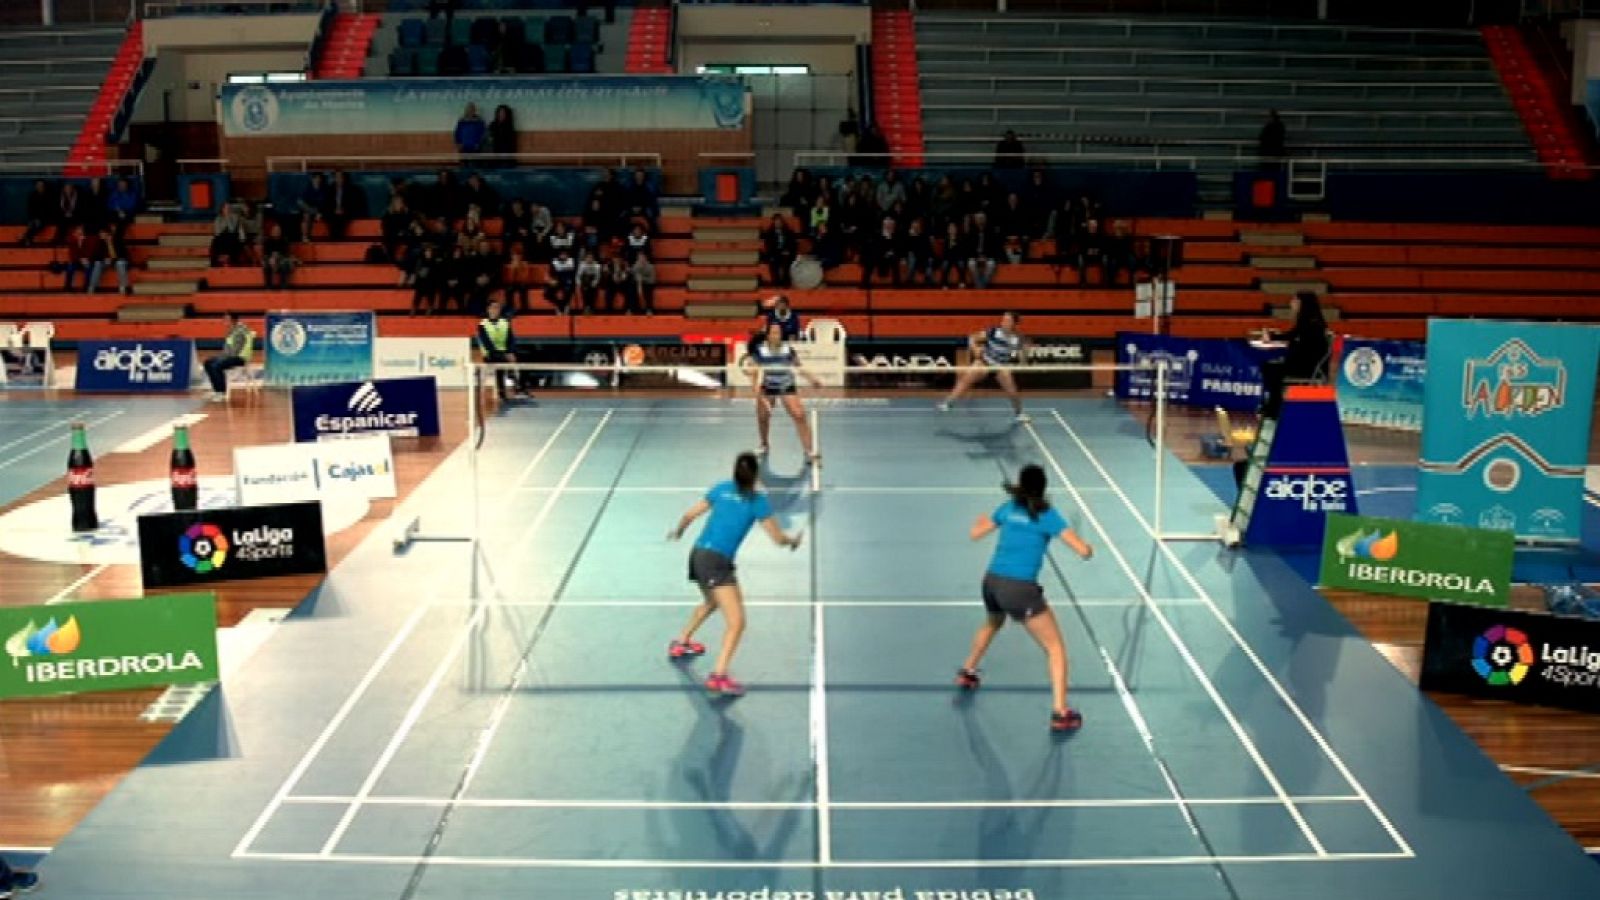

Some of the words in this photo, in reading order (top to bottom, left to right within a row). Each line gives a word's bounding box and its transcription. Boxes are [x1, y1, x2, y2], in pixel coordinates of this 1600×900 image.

[93, 343, 175, 381] aiqbe
[232, 524, 294, 546] LaLiga
[1348, 562, 1495, 596] IBERDROLA
[26, 650, 204, 683] IBERDROLA
[1541, 642, 1600, 673] LaLig
